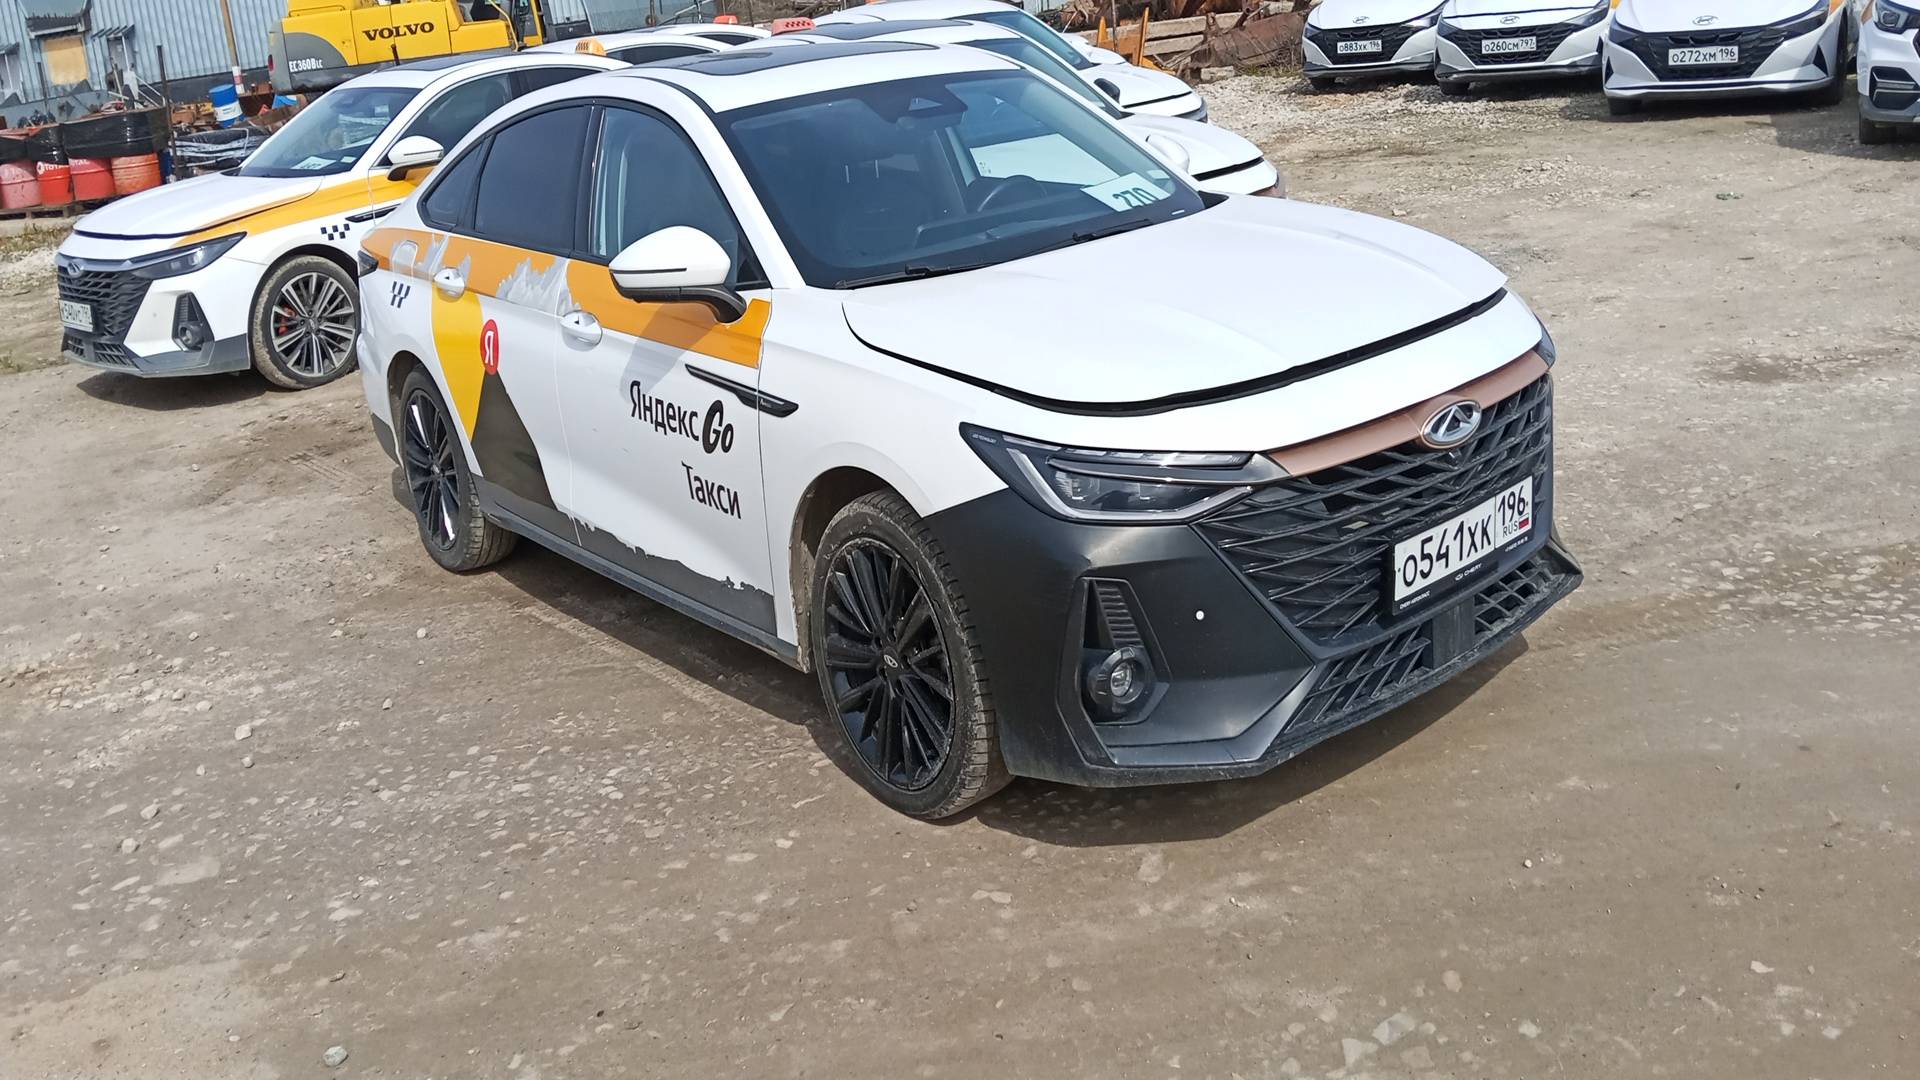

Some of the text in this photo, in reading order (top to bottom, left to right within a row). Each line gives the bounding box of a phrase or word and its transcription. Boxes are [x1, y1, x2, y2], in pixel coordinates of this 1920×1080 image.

[363, 22, 434, 41] VOLVO
[1719, 47, 1736, 58] 196
[1112, 187, 1159, 208] 270
[484, 330, 494, 366] Я
[630, 380, 734, 454] Яндекс Go
[681, 460, 741, 519] Такси
[1402, 485, 1526, 587] О541ХК 196
[1503, 522, 1519, 538] RUS
